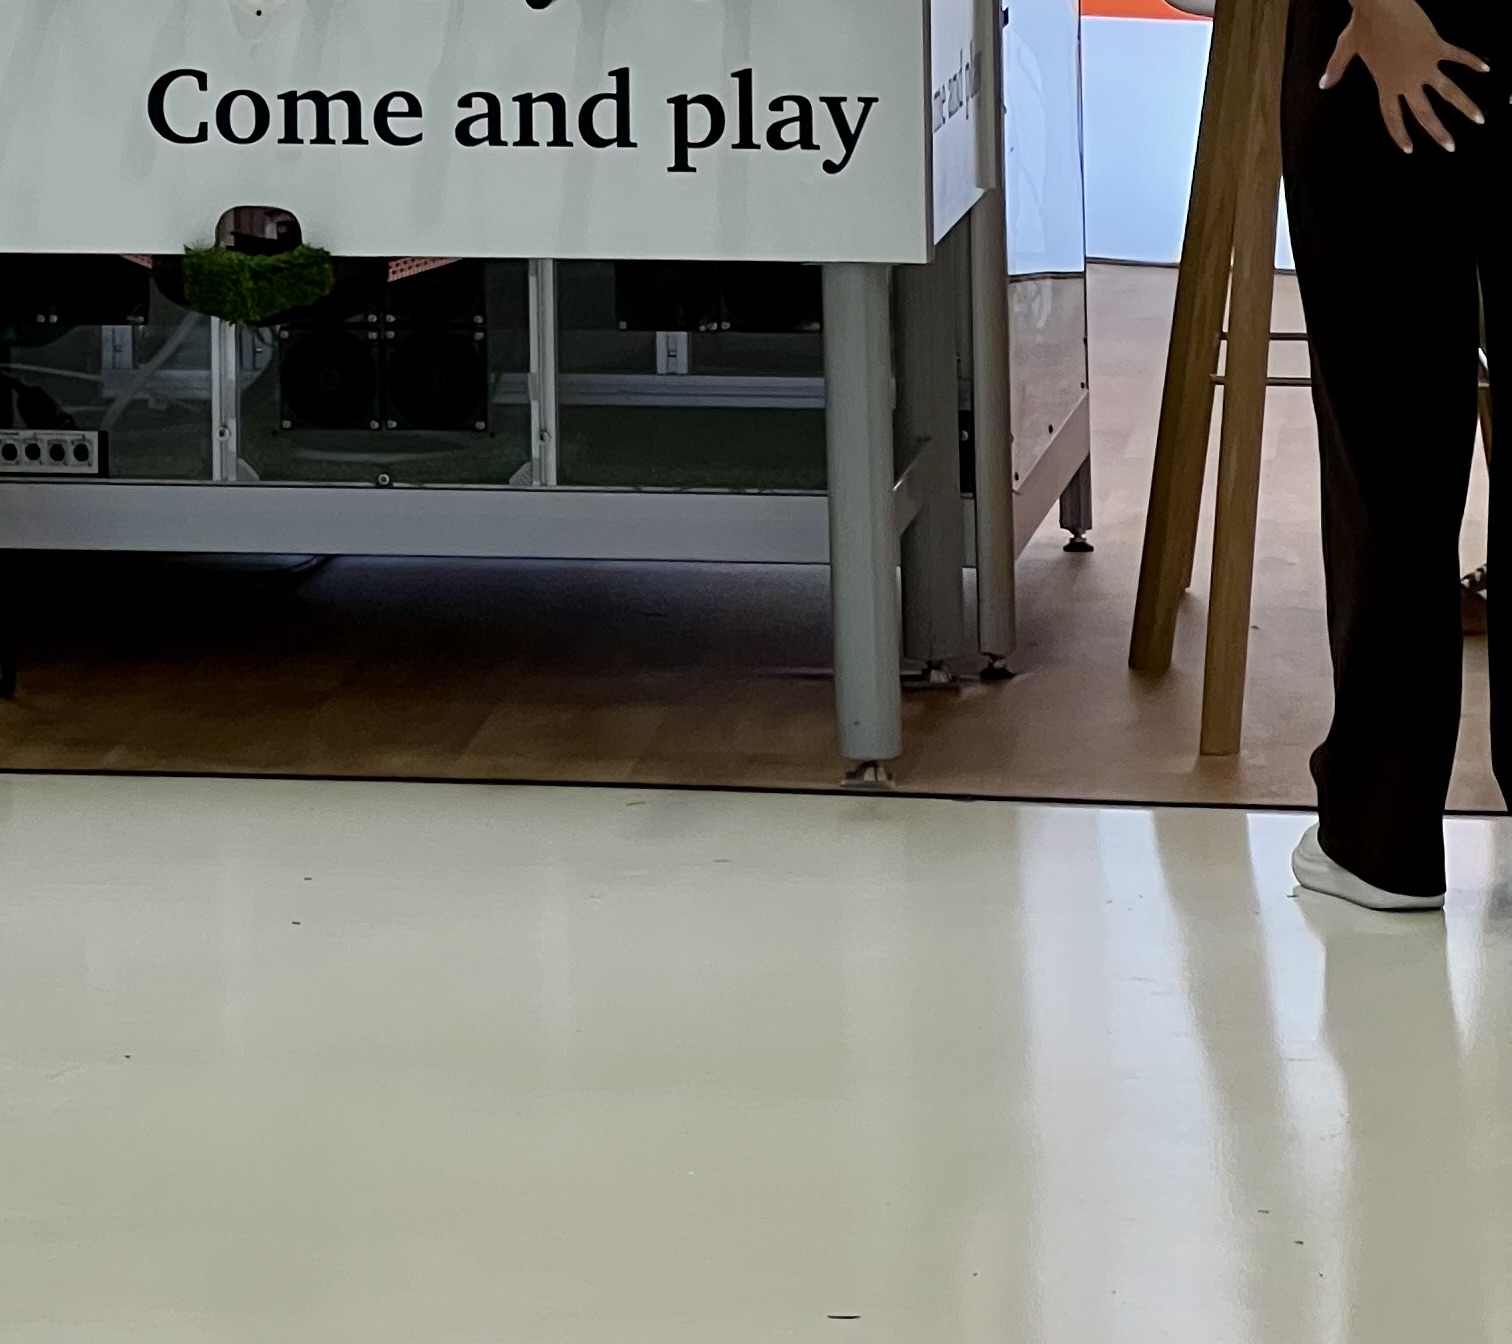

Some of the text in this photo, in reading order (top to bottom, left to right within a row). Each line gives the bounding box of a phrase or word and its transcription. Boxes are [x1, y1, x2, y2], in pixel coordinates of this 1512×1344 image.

[147, 67, 880, 175] Come and play
